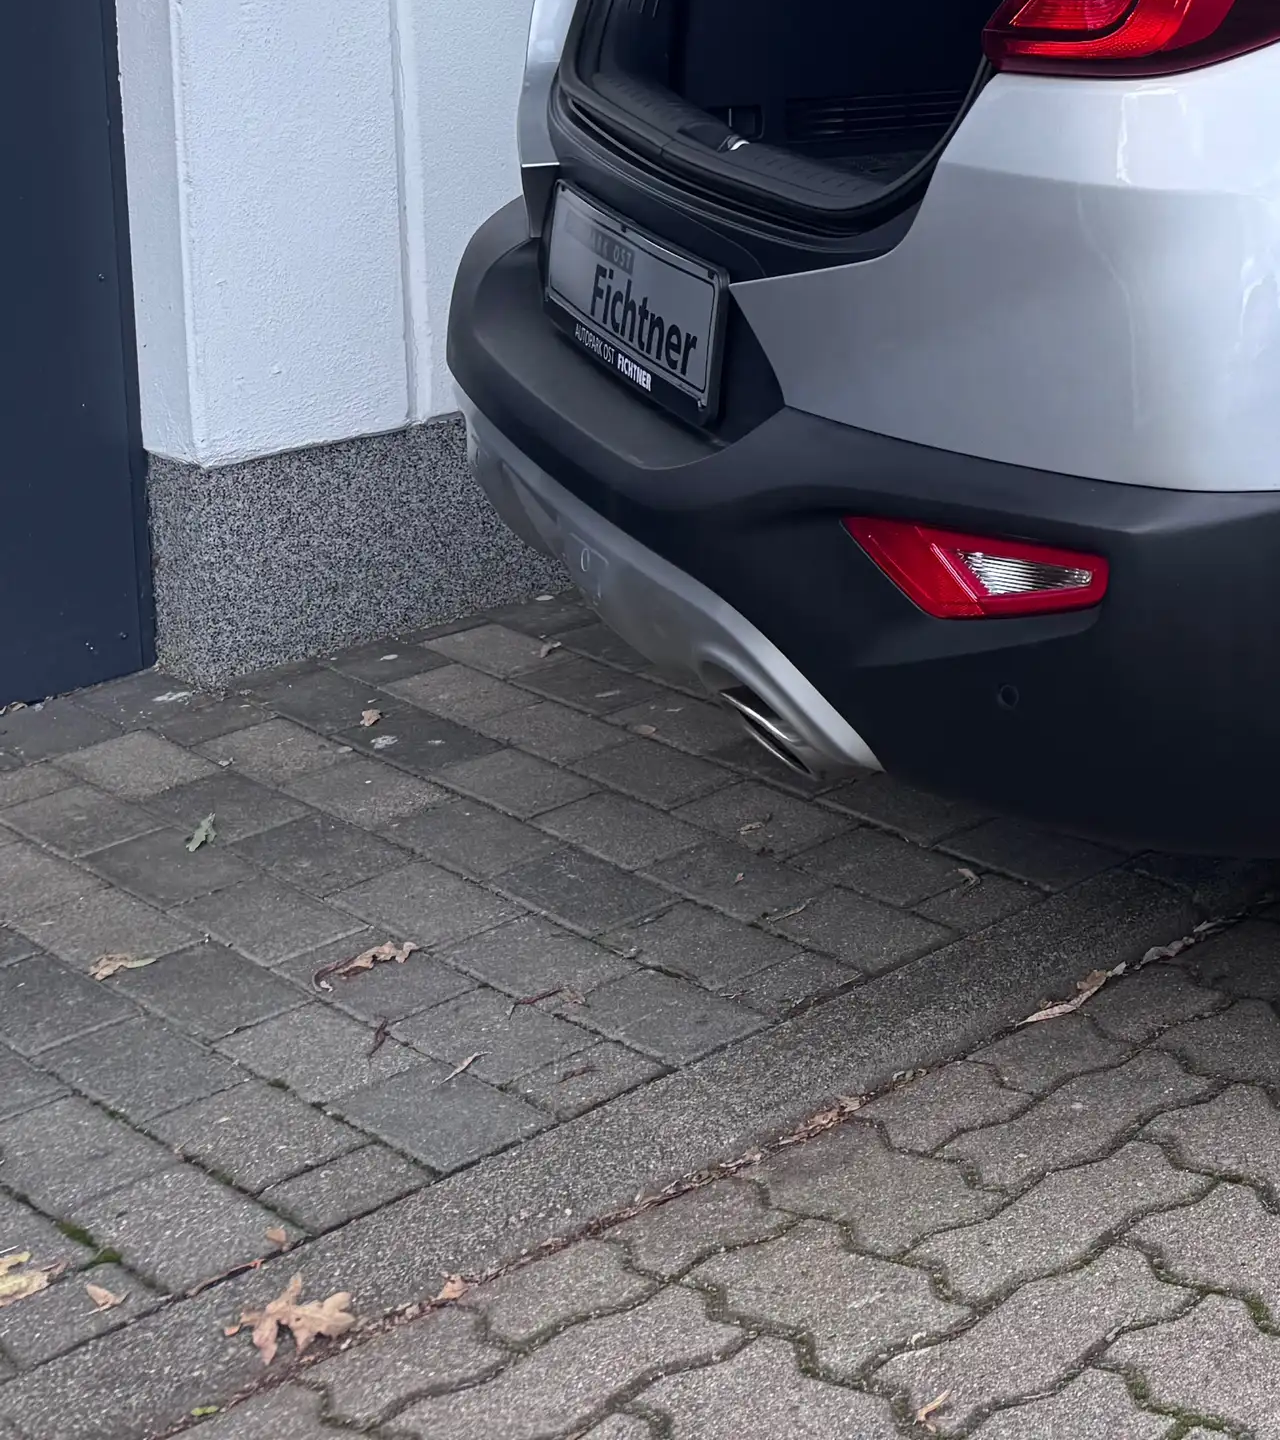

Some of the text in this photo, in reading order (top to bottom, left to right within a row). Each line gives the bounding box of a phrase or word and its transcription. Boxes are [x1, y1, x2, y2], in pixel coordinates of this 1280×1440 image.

[574, 322, 652, 392] AUTOPARK OST FICHTNER
[590, 263, 698, 376] Fichtner
